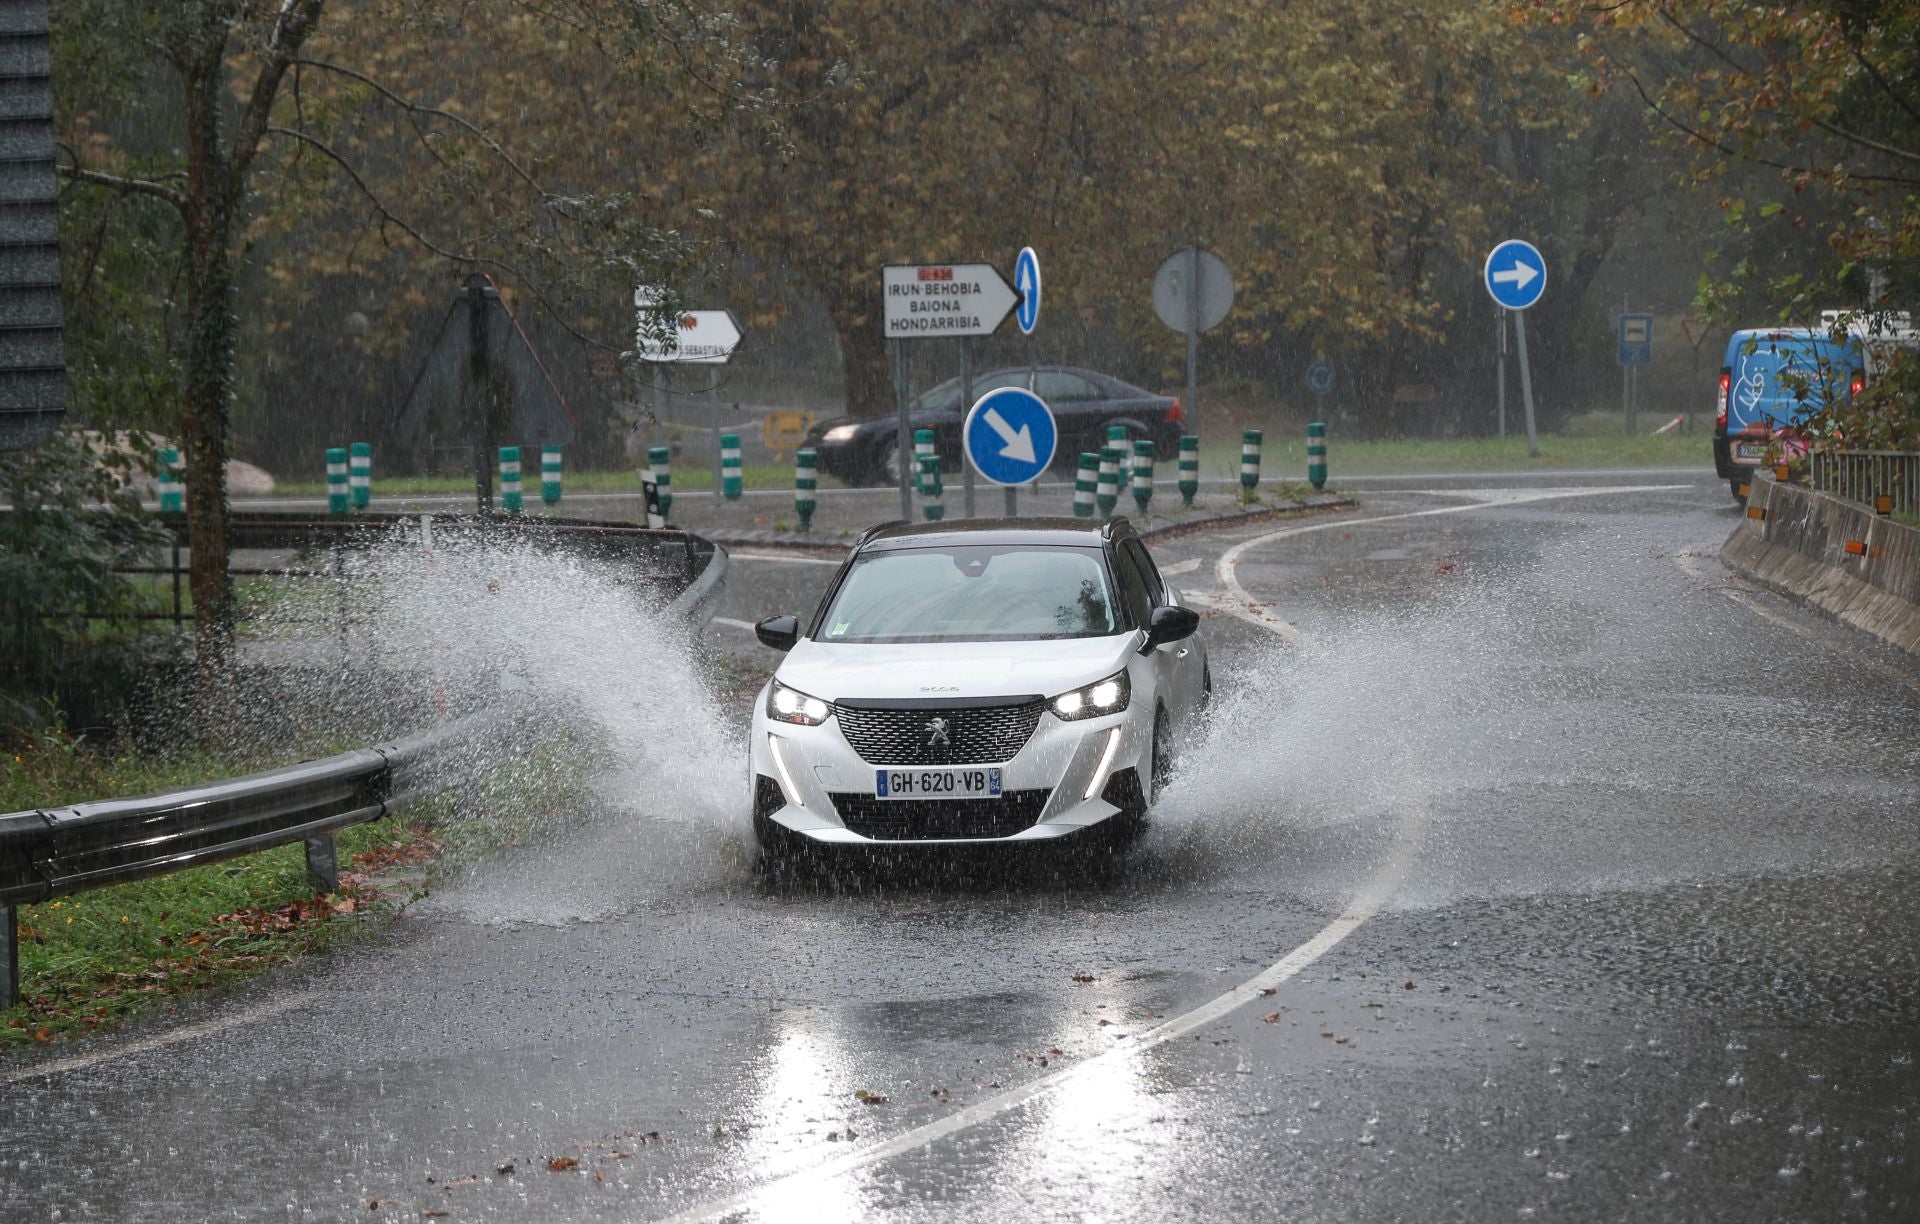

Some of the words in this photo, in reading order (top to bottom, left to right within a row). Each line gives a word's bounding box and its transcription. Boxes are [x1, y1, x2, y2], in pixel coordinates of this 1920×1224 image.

[888, 282, 981, 296] IRUN-BEHOBIA
[910, 300, 961, 313] BAIONA
[890, 316, 981, 331] HONDARRIBIA
[891, 771, 985, 793] GH-620-VB
